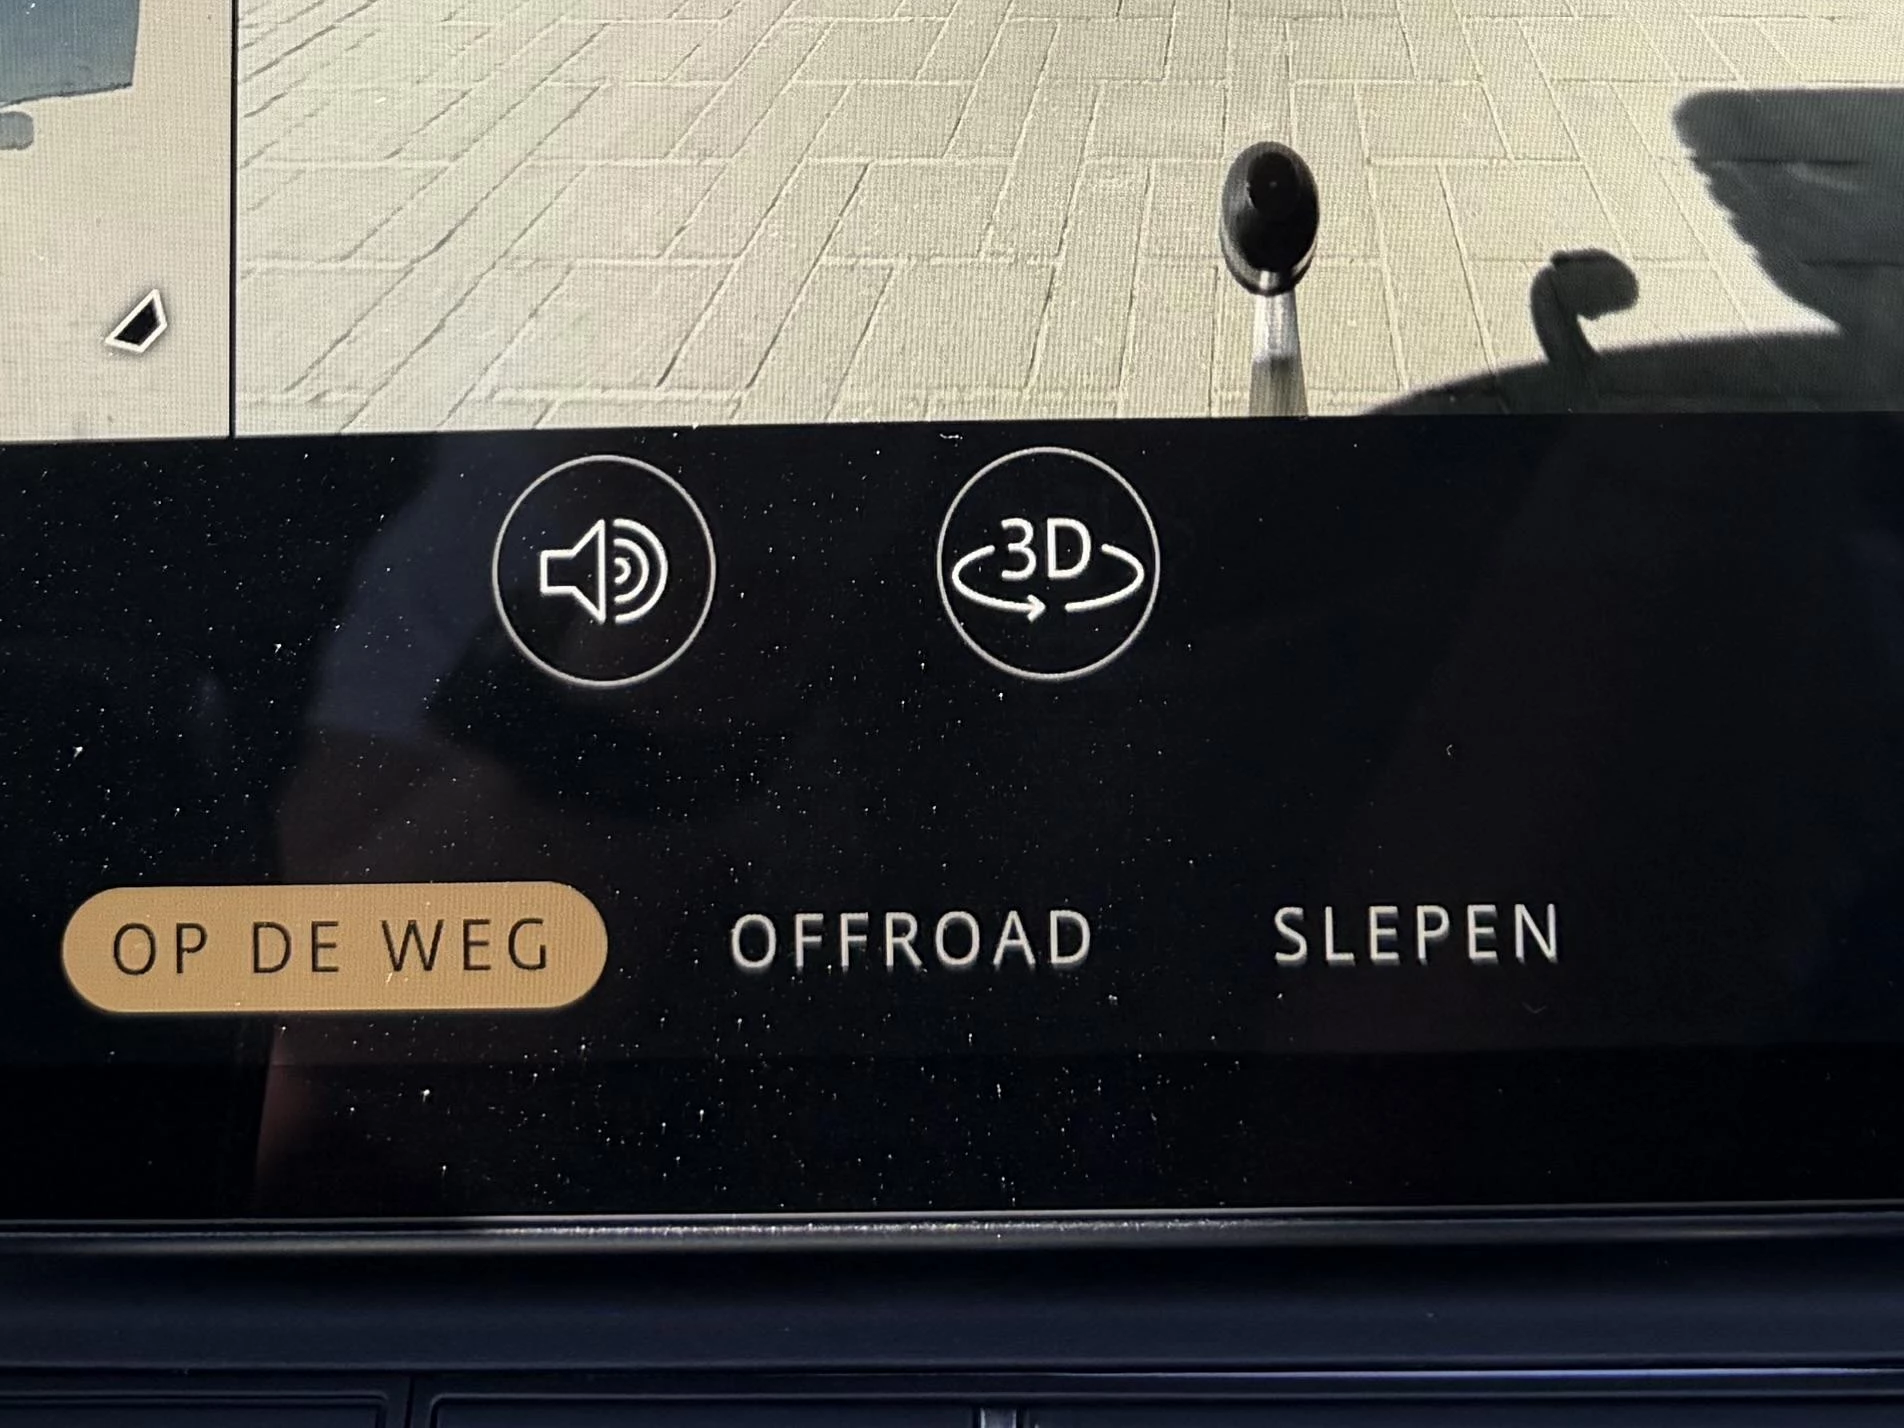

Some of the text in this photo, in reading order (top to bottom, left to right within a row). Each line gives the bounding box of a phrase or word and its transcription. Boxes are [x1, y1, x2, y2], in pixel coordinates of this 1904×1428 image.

[999, 516, 1093, 581] 3D
[112, 917, 548, 977] OP DE WEG
[730, 908, 1092, 970] OFFROAD
[1273, 902, 1560, 963] SLEPEN
